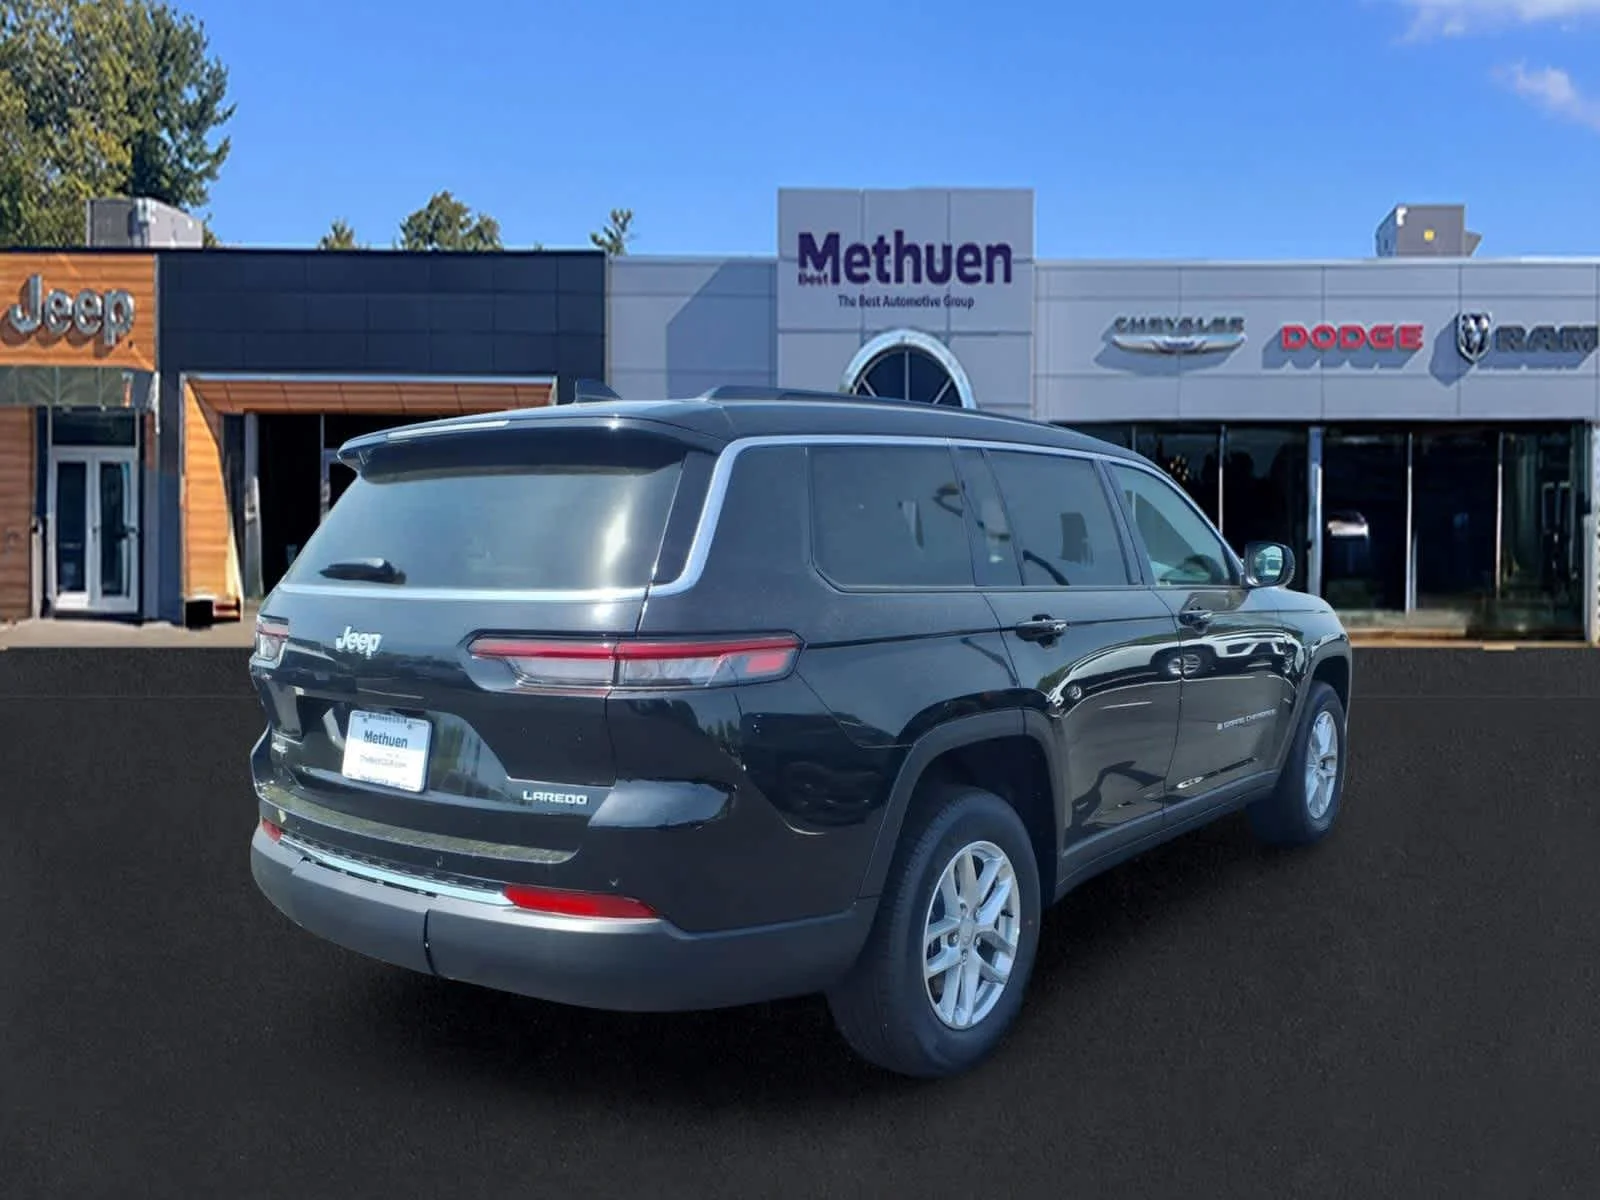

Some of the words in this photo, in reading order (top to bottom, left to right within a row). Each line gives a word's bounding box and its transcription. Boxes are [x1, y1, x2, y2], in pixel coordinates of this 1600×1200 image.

[798, 230, 1012, 285] Methuen
[798, 273, 828, 286] Best
[9, 274, 135, 346] Jeep
[838, 295, 856, 308] The
[859, 295, 881, 308] Best
[883, 295, 940, 308] Automotive
[943, 295, 975, 310] Group
[1114, 316, 1244, 334] CHRYSLER
[1281, 324, 1424, 351] DODGE
[1495, 325, 1599, 353] RAM
[335, 626, 382, 658] Jeep
[363, 730, 409, 749] Methuen
[522, 789, 588, 805] LAREDO
